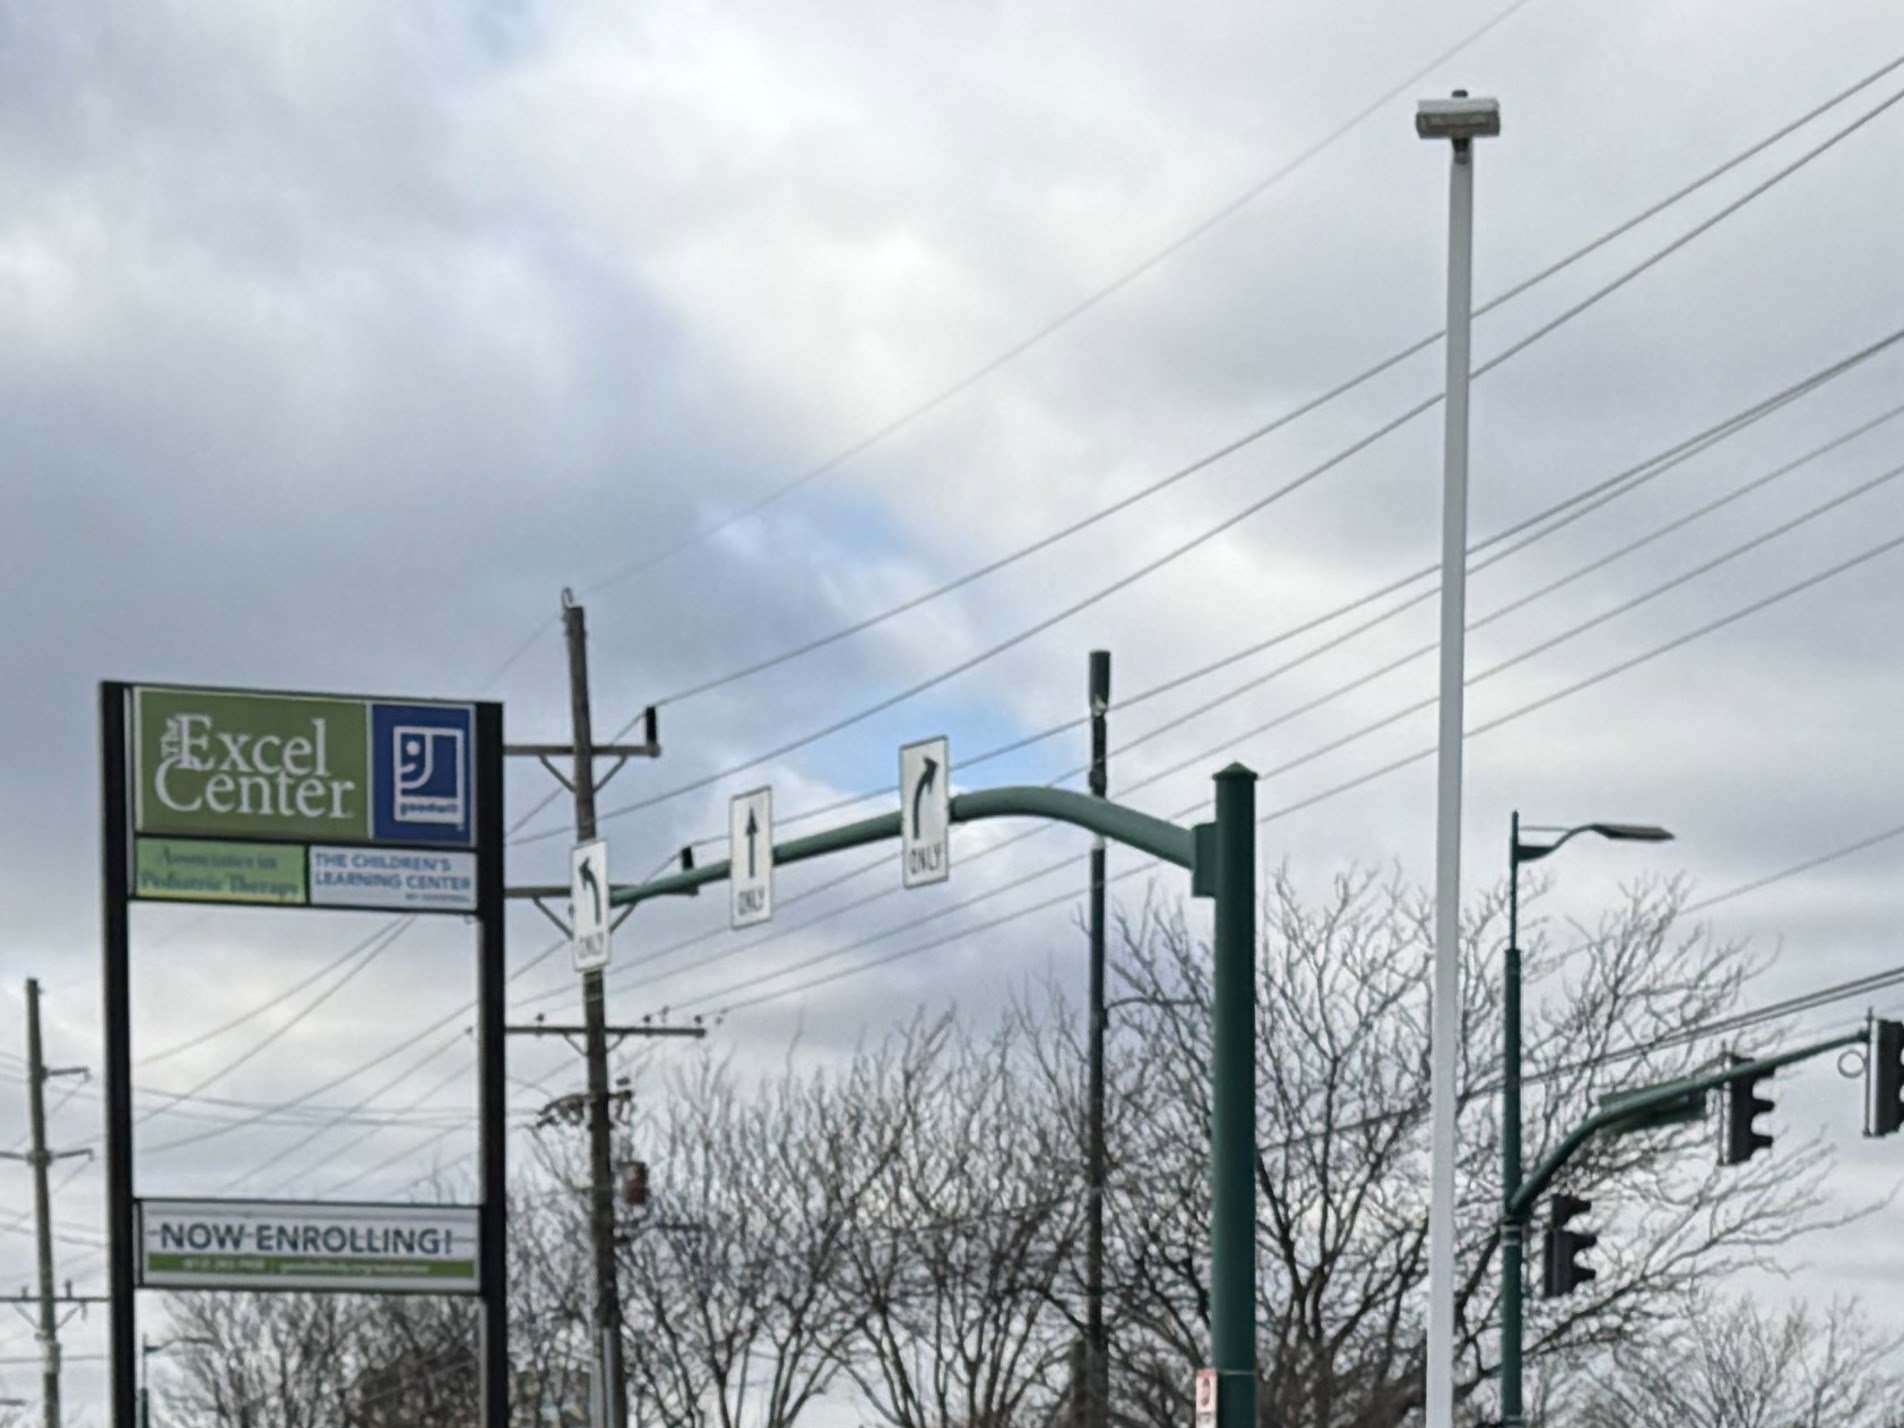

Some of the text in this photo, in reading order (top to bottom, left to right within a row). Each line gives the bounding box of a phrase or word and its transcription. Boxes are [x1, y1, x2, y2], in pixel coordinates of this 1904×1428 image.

[175, 713, 328, 777] Excel
[154, 757, 356, 819] Center
[315, 852, 452, 872] THE CHILDREN'S
[908, 843, 942, 876] ONLY
[315, 871, 472, 891] LEARNING CENTER
[160, 1222, 453, 1257] NOW ENROLLING!
